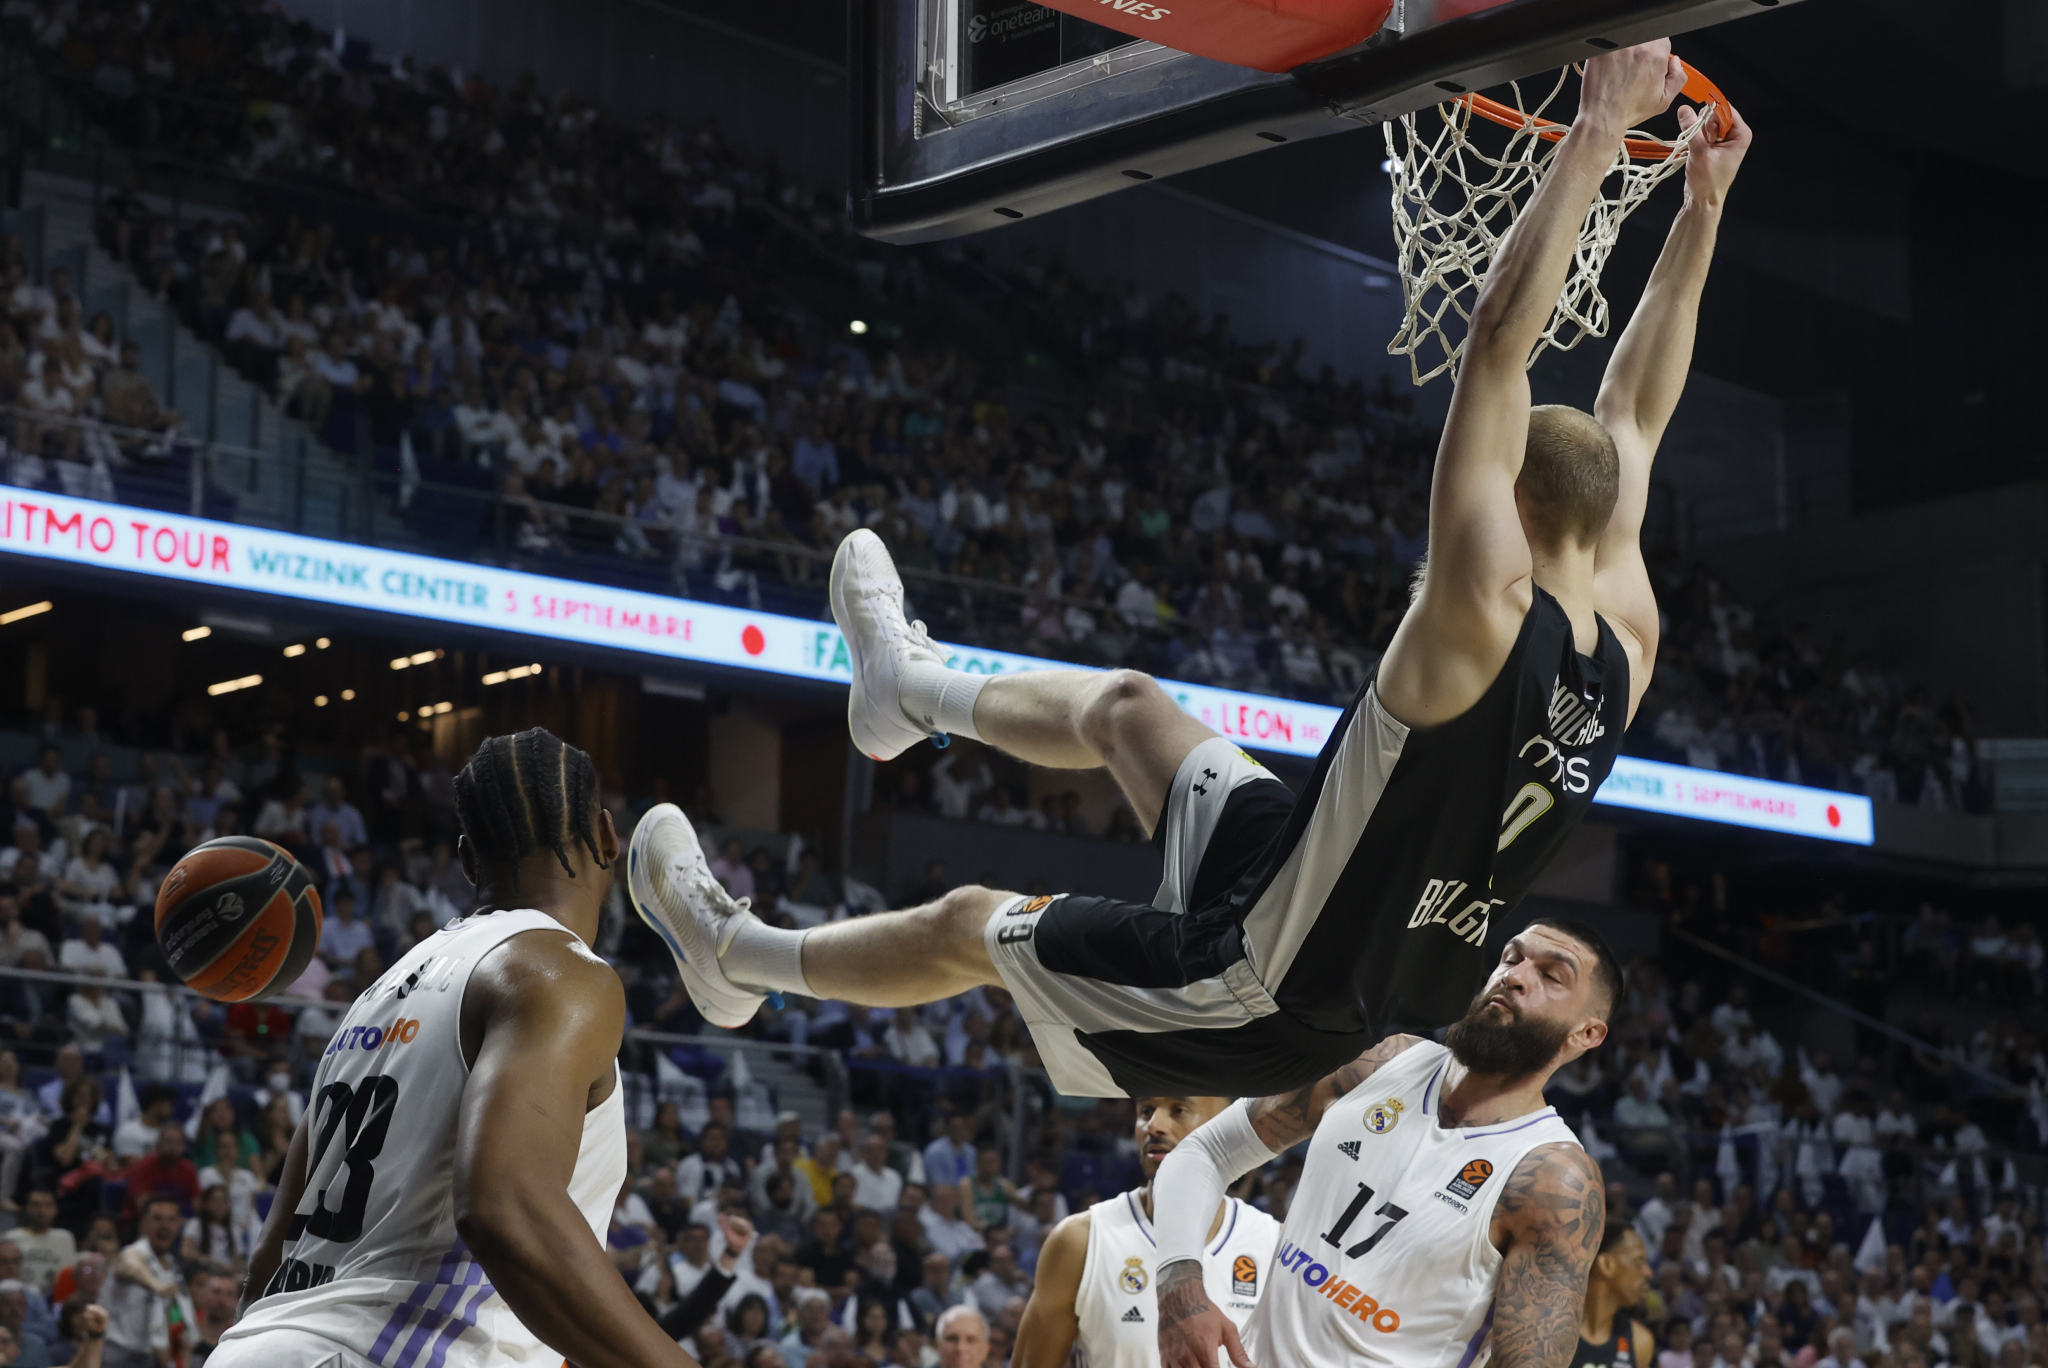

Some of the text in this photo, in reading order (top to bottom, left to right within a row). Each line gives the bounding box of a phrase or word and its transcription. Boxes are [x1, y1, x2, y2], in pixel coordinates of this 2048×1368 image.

[1094, 0, 1172, 20] NES
[0, 500, 692, 641] ITMO TOUR WIZINK CENTER 5 SEPTIEMBRE
[1222, 703, 1293, 743] LEON
[1602, 770, 1664, 797] ENTER
[1320, 1182, 1409, 1259] 17
[1434, 1191, 1468, 1214] oneteam
[1277, 1239, 1400, 1333] UTOHERO
